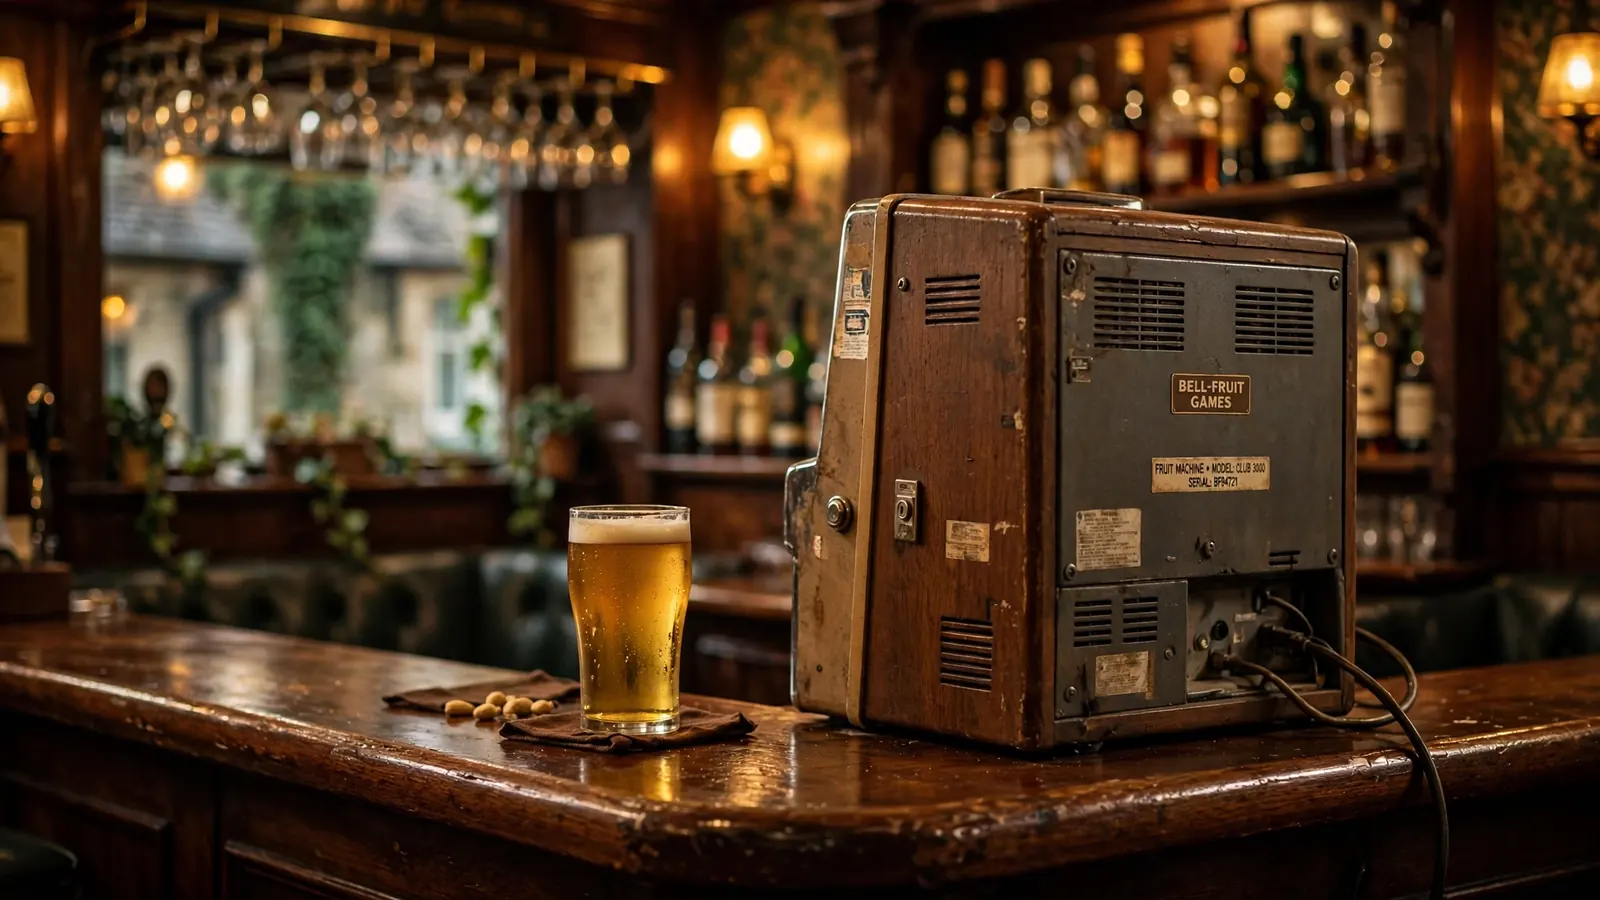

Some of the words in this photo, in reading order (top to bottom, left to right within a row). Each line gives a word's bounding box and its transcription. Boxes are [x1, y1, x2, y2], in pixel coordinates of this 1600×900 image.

[1178, 379, 1245, 394] BELL-FRUIT
[1190, 395, 1232, 409] GAMES
[1155, 463, 1174, 475] FRUIT
[1175, 462, 1205, 475] MACHINE
[1236, 462, 1251, 474] CLUB
[1252, 462, 1266, 473] 3000
